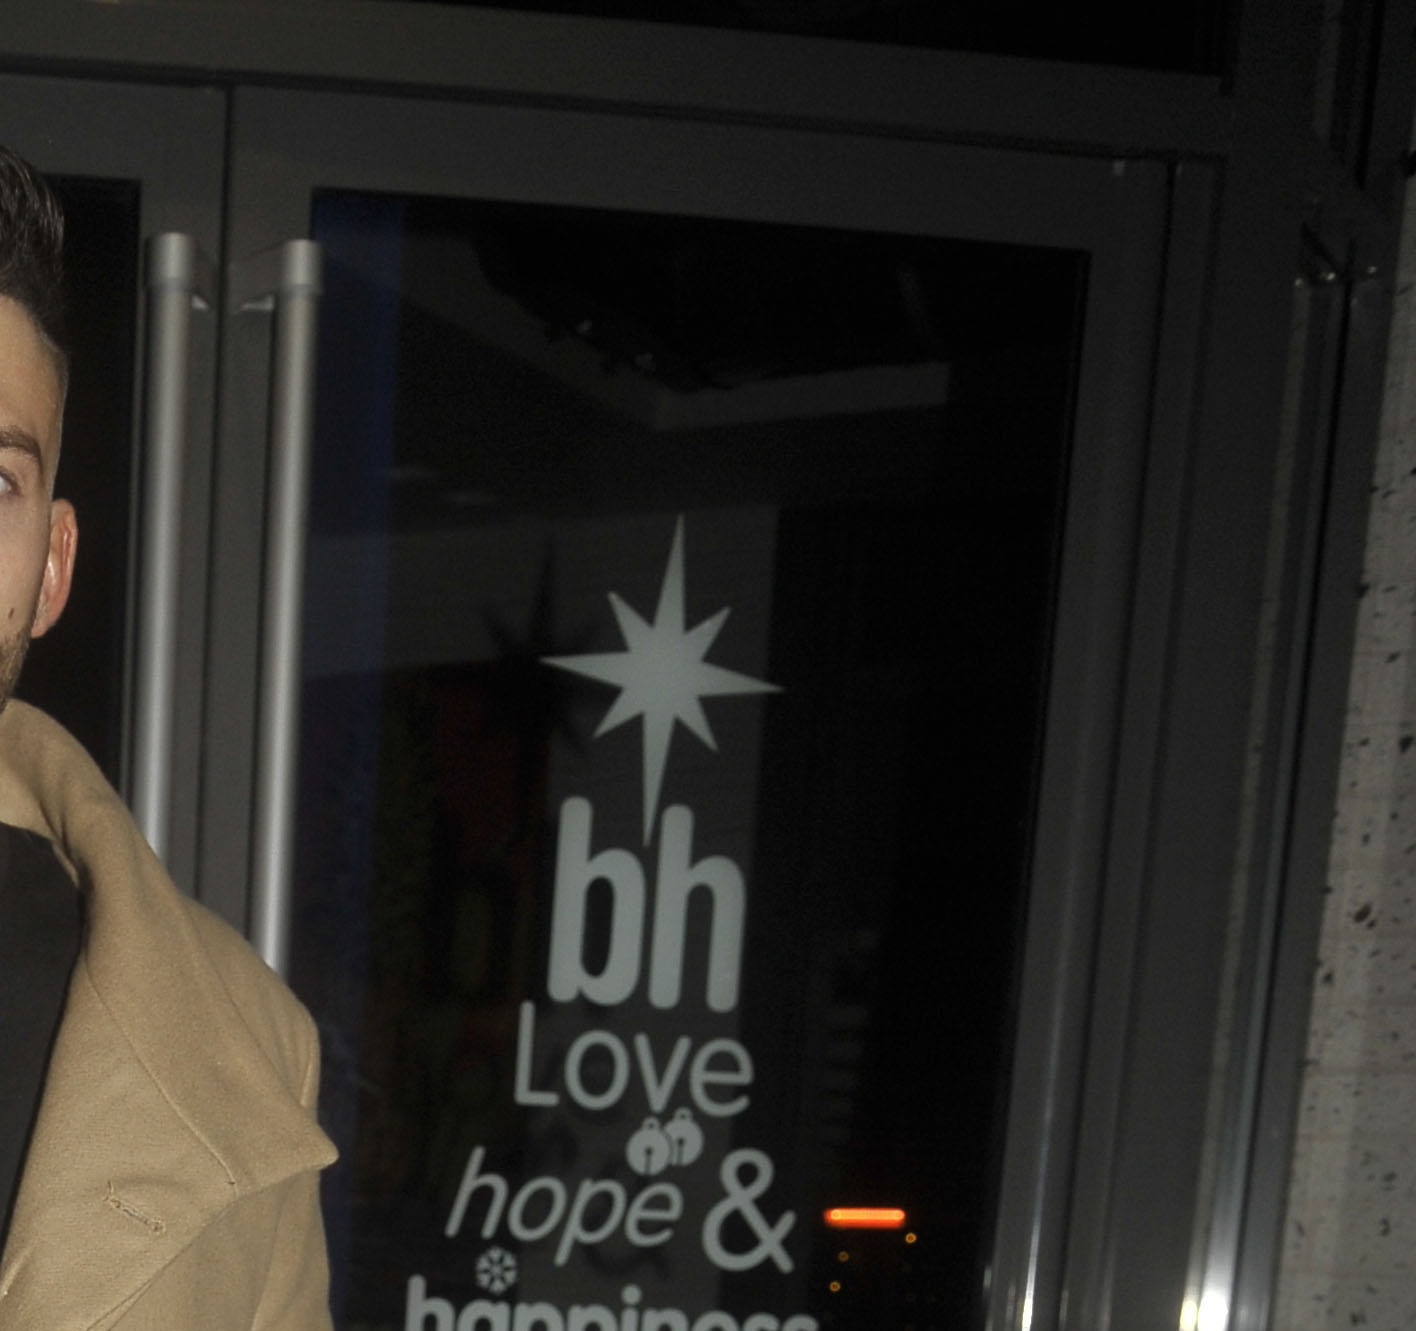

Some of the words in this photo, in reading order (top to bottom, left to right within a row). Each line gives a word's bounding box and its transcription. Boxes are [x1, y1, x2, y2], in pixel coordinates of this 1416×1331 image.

[548, 796, 745, 1013] bh
[515, 1001, 753, 1118] Love
[445, 1146, 684, 1266] hope
[701, 1148, 796, 1273] &
